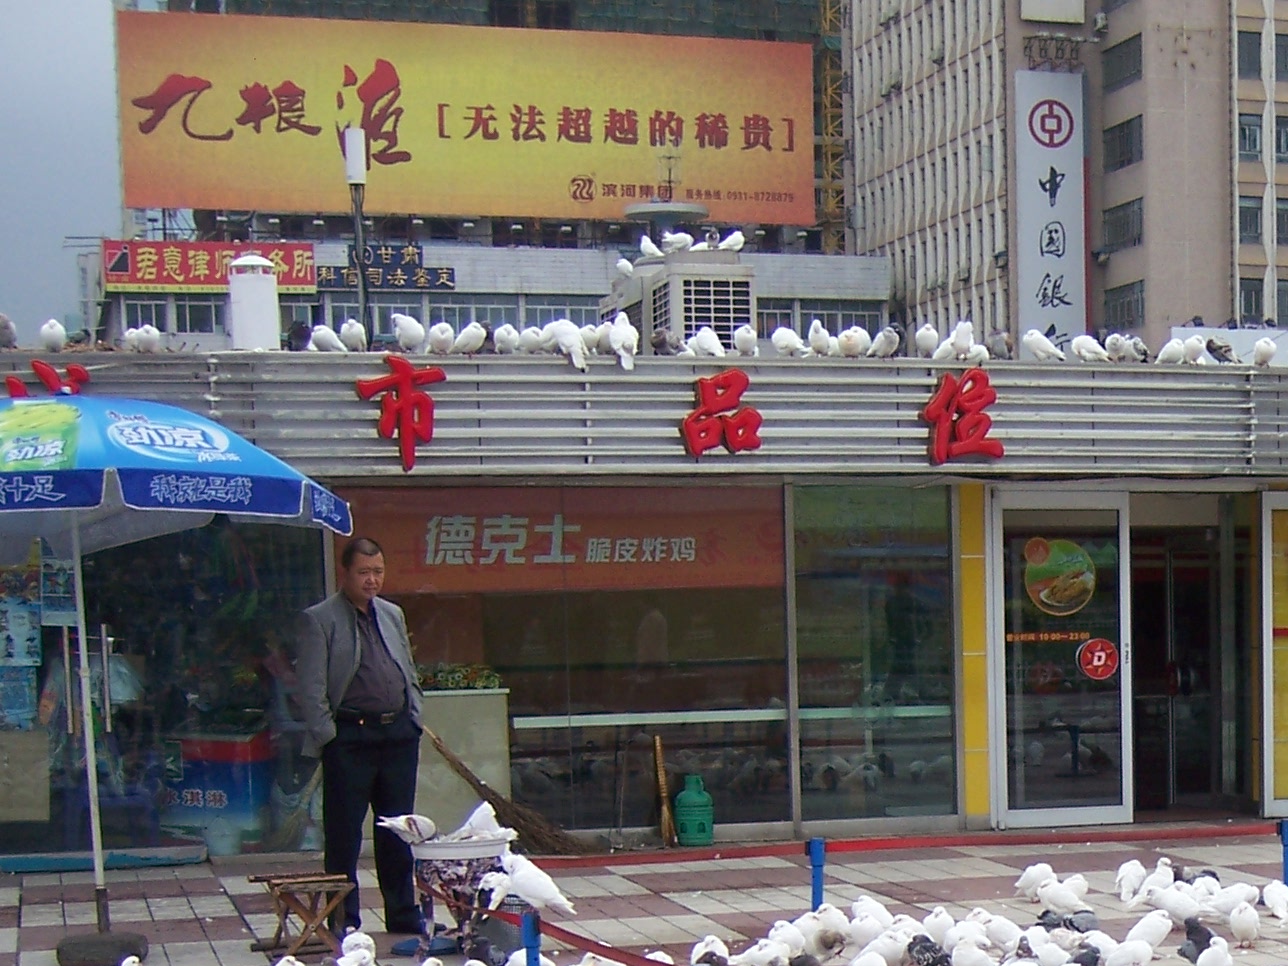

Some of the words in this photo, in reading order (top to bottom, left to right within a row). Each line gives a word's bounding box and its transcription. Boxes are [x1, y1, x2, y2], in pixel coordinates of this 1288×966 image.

[135, 246, 314, 282] 君意律师务所
[377, 245, 421, 265] 甘肃
[317, 266, 455, 287] 科信司法鉴定
[0, 475, 66, 505] 十足
[150, 474, 253, 505] 我就是我
[424, 514, 581, 565] 德克士
[585, 536, 697, 563] 脆皮炸鸡
[1092, 651, 1107, 666] D
